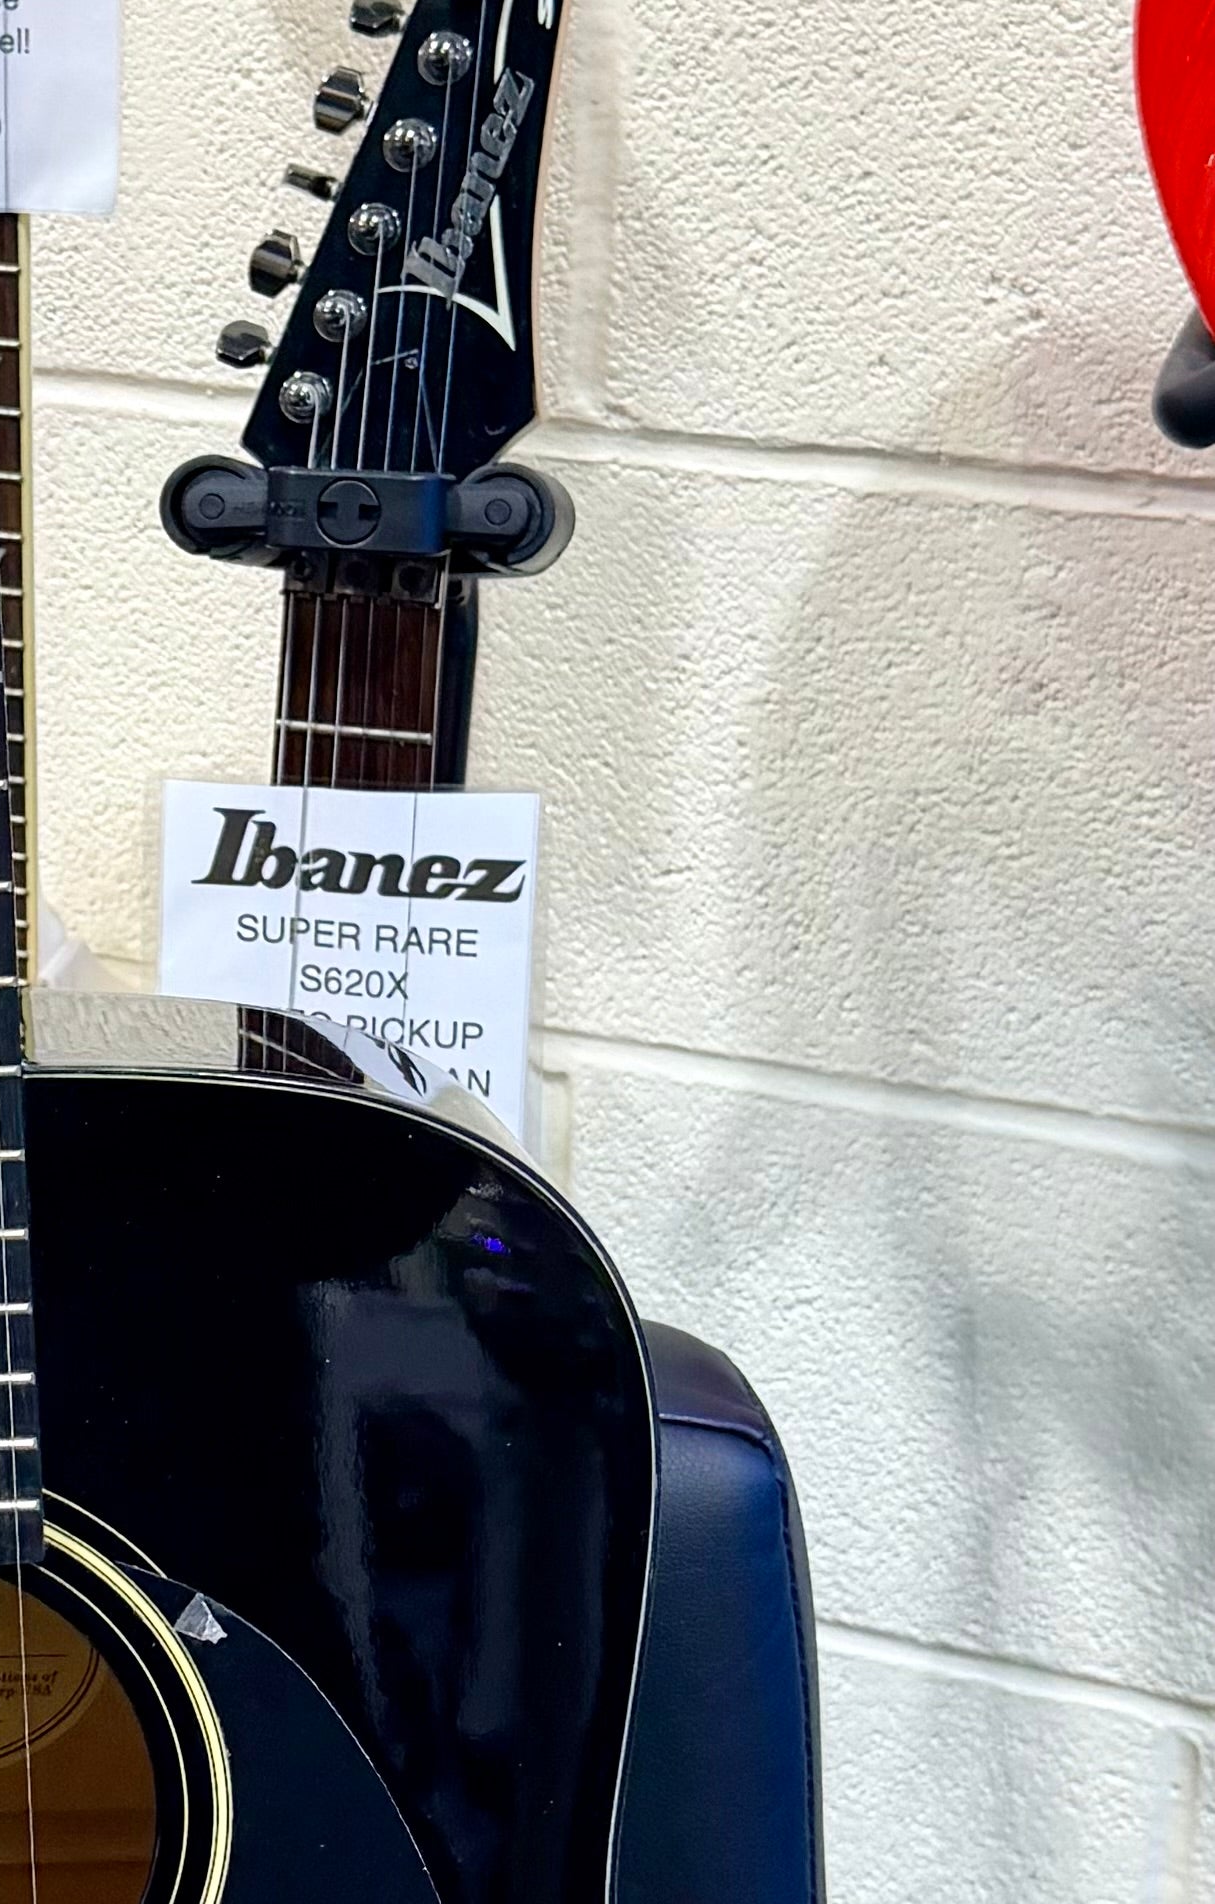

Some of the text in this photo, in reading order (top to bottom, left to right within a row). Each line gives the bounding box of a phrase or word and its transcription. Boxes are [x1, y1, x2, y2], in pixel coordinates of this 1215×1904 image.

[401, 67, 535, 311] Ibanez
[191, 807, 527, 903] Ibanez
[237, 914, 479, 958] SUPER RARE
[299, 964, 409, 1000] S620X
